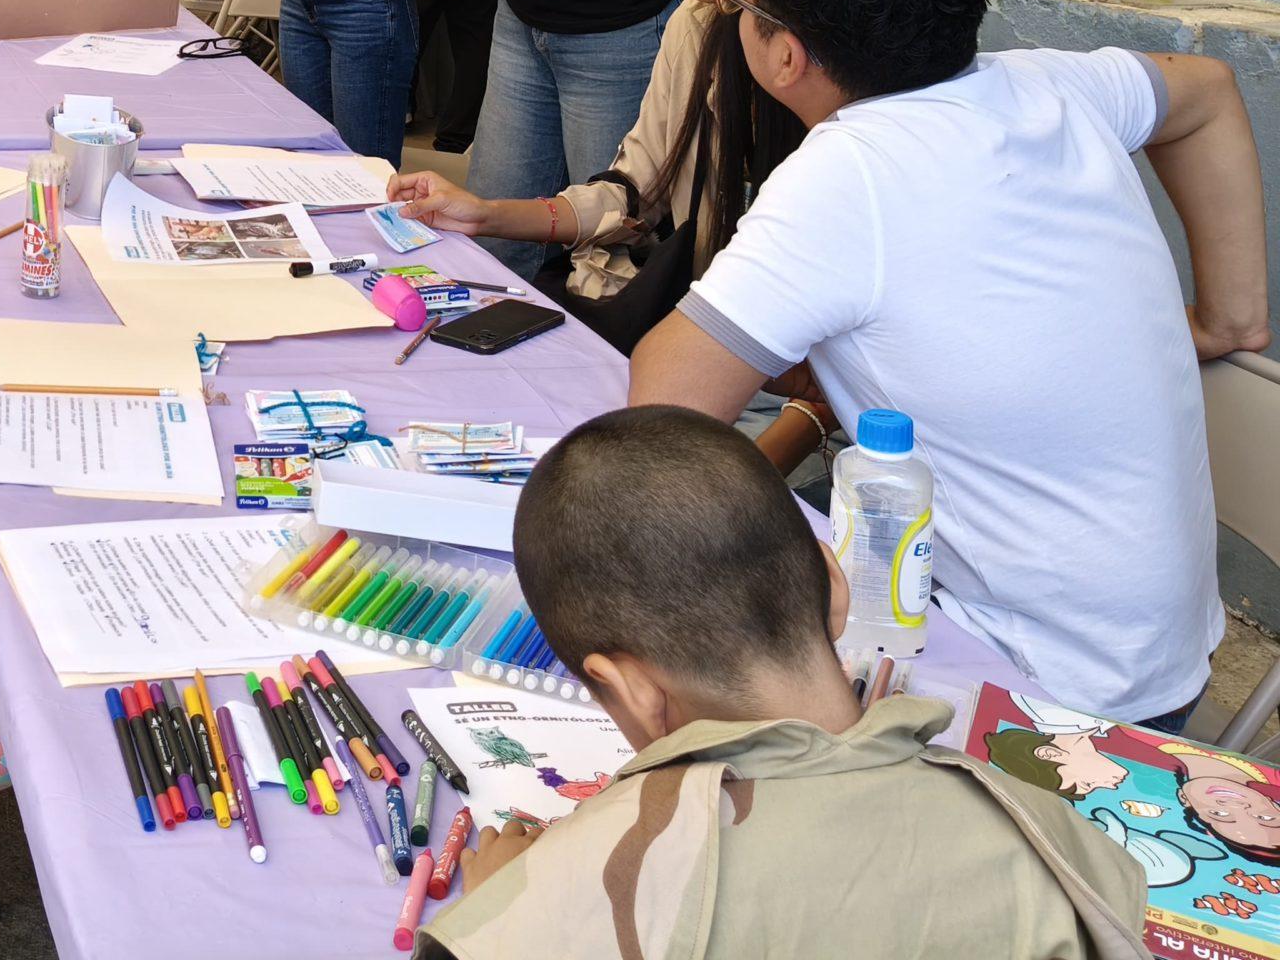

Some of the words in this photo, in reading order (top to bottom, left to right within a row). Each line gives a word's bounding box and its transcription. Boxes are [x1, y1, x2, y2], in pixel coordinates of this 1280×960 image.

[245, 446, 283, 454] Pelikan
[239, 498, 259, 506] Pelikan
[451, 703, 514, 713] TALLER
[1153, 931, 1185, 951] AL
[1156, 926, 1235, 955] interactivo
